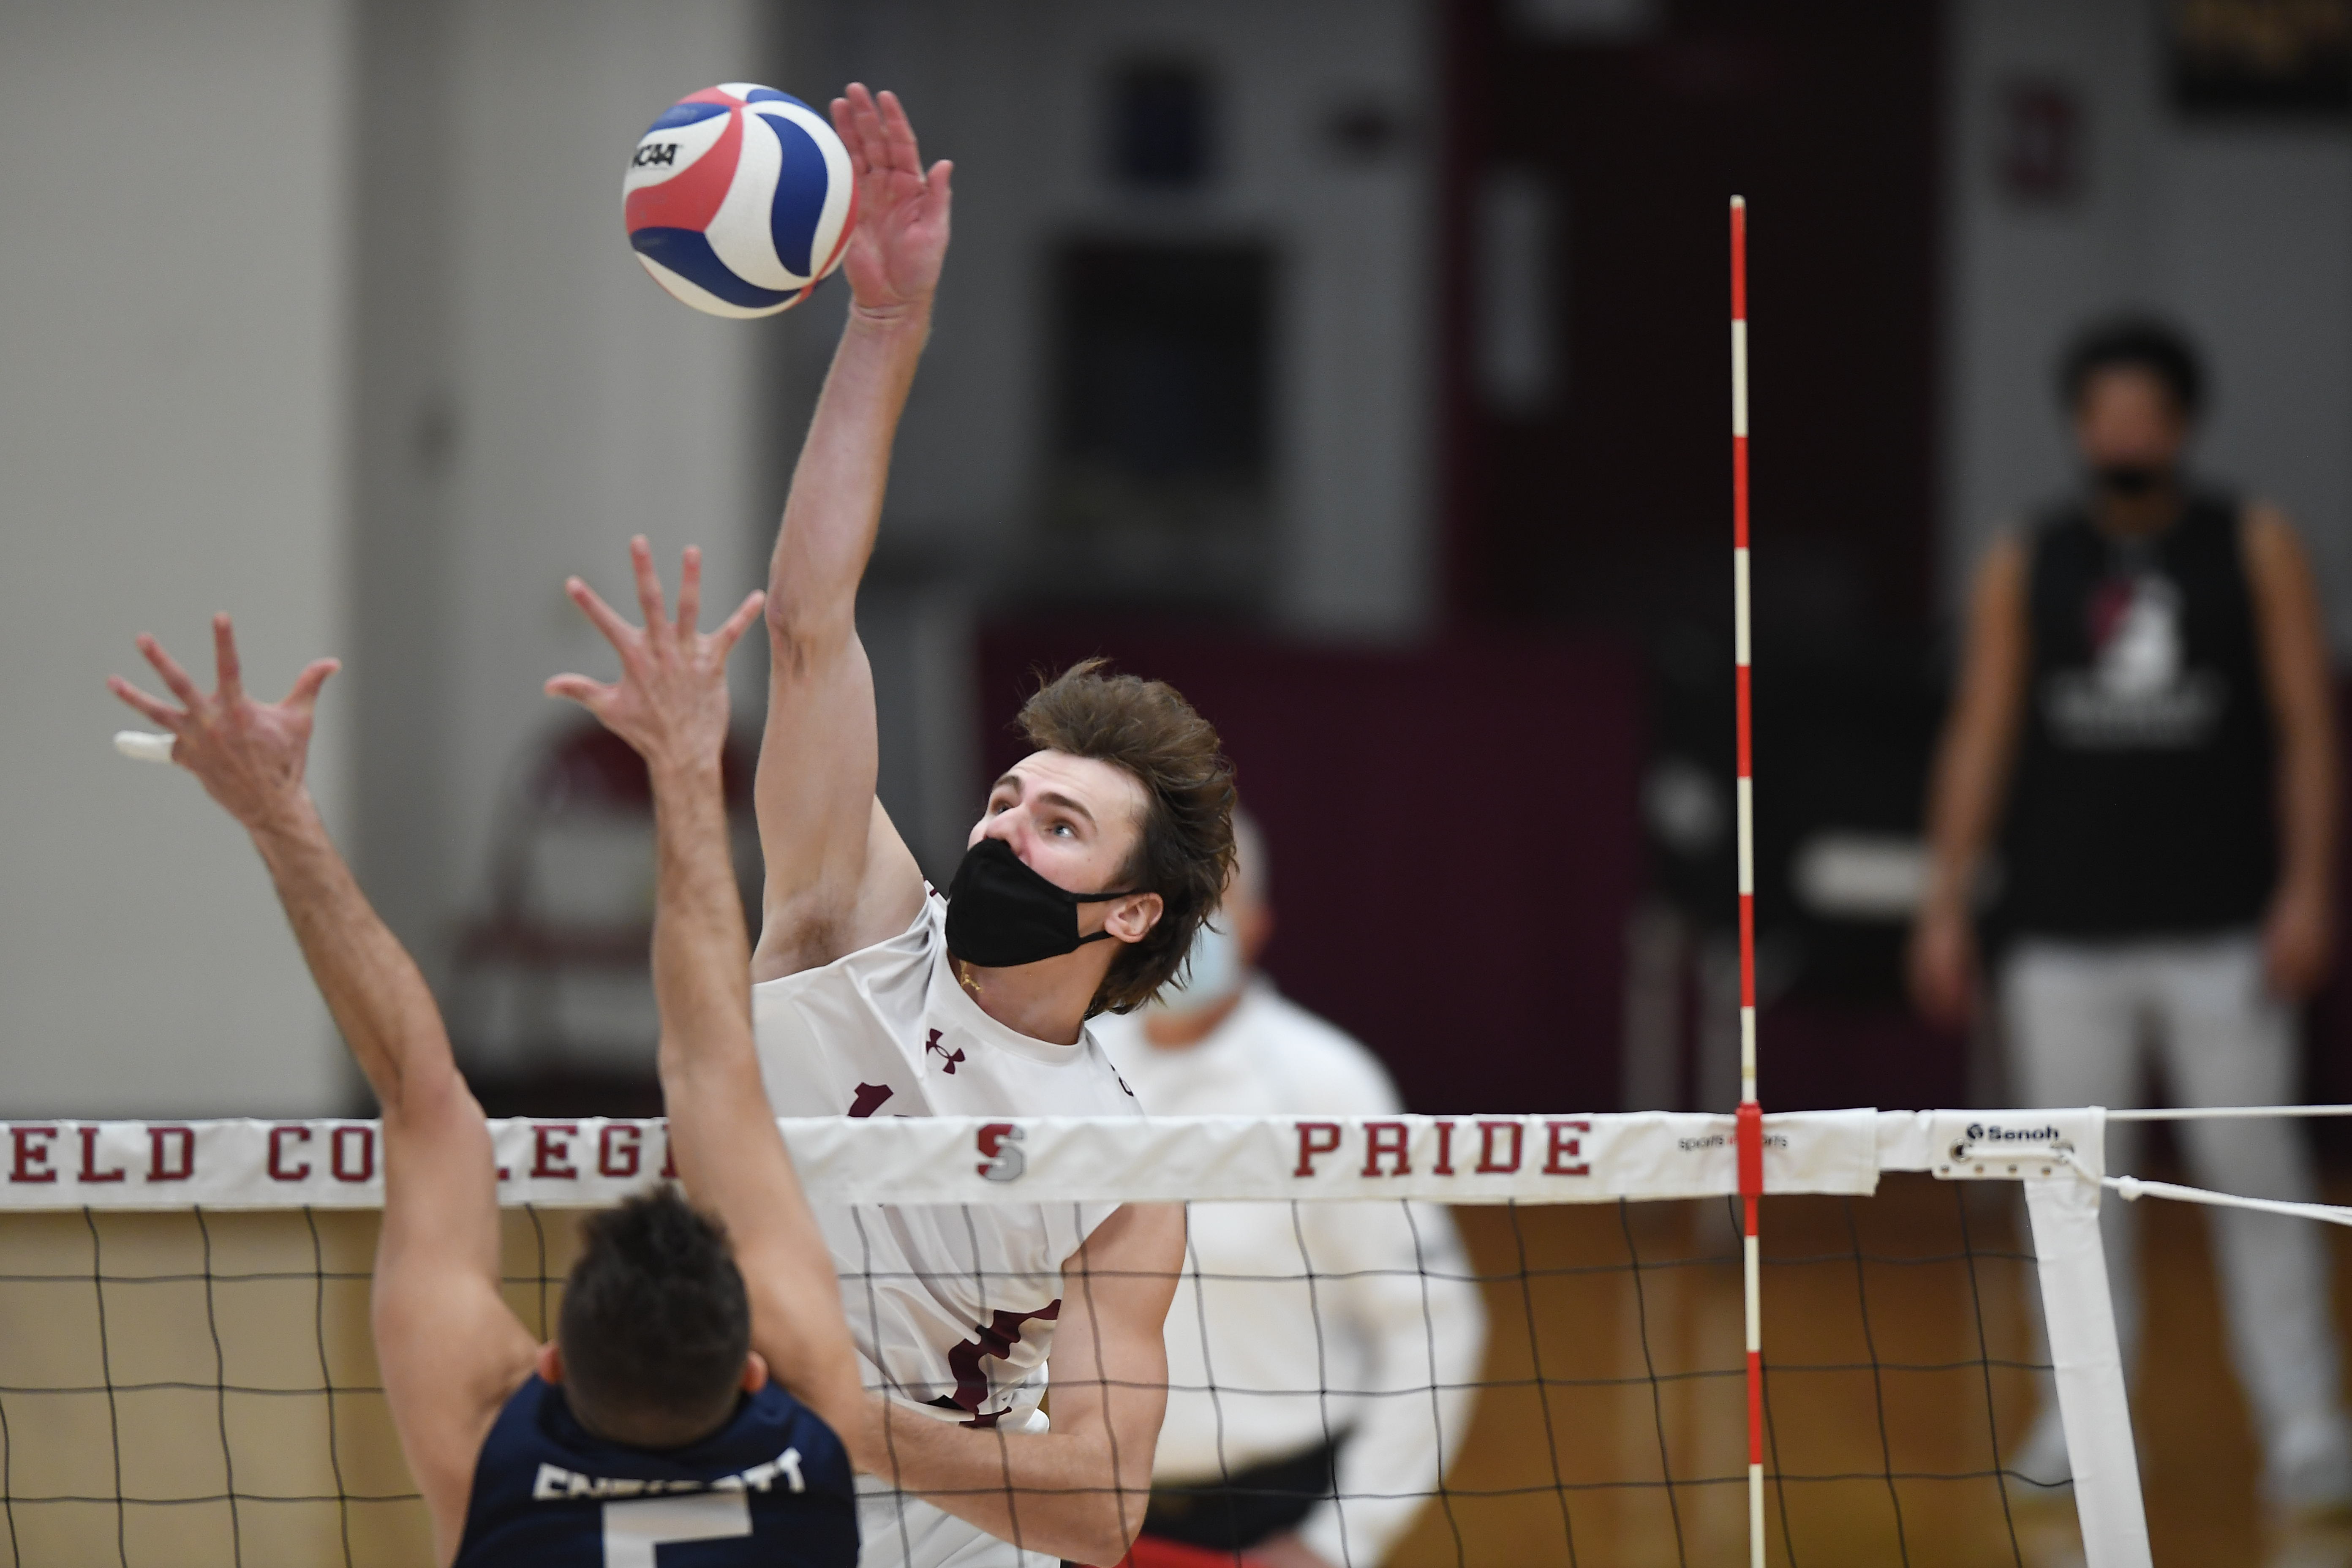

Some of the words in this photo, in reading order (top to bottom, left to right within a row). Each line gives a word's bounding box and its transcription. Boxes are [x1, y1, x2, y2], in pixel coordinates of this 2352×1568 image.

[9, 1127, 193, 1182] ELD
[977, 1123, 1024, 1181] S
[1294, 1121, 1590, 1177] PRIDE
[1989, 1124, 2058, 1140] Senoh
